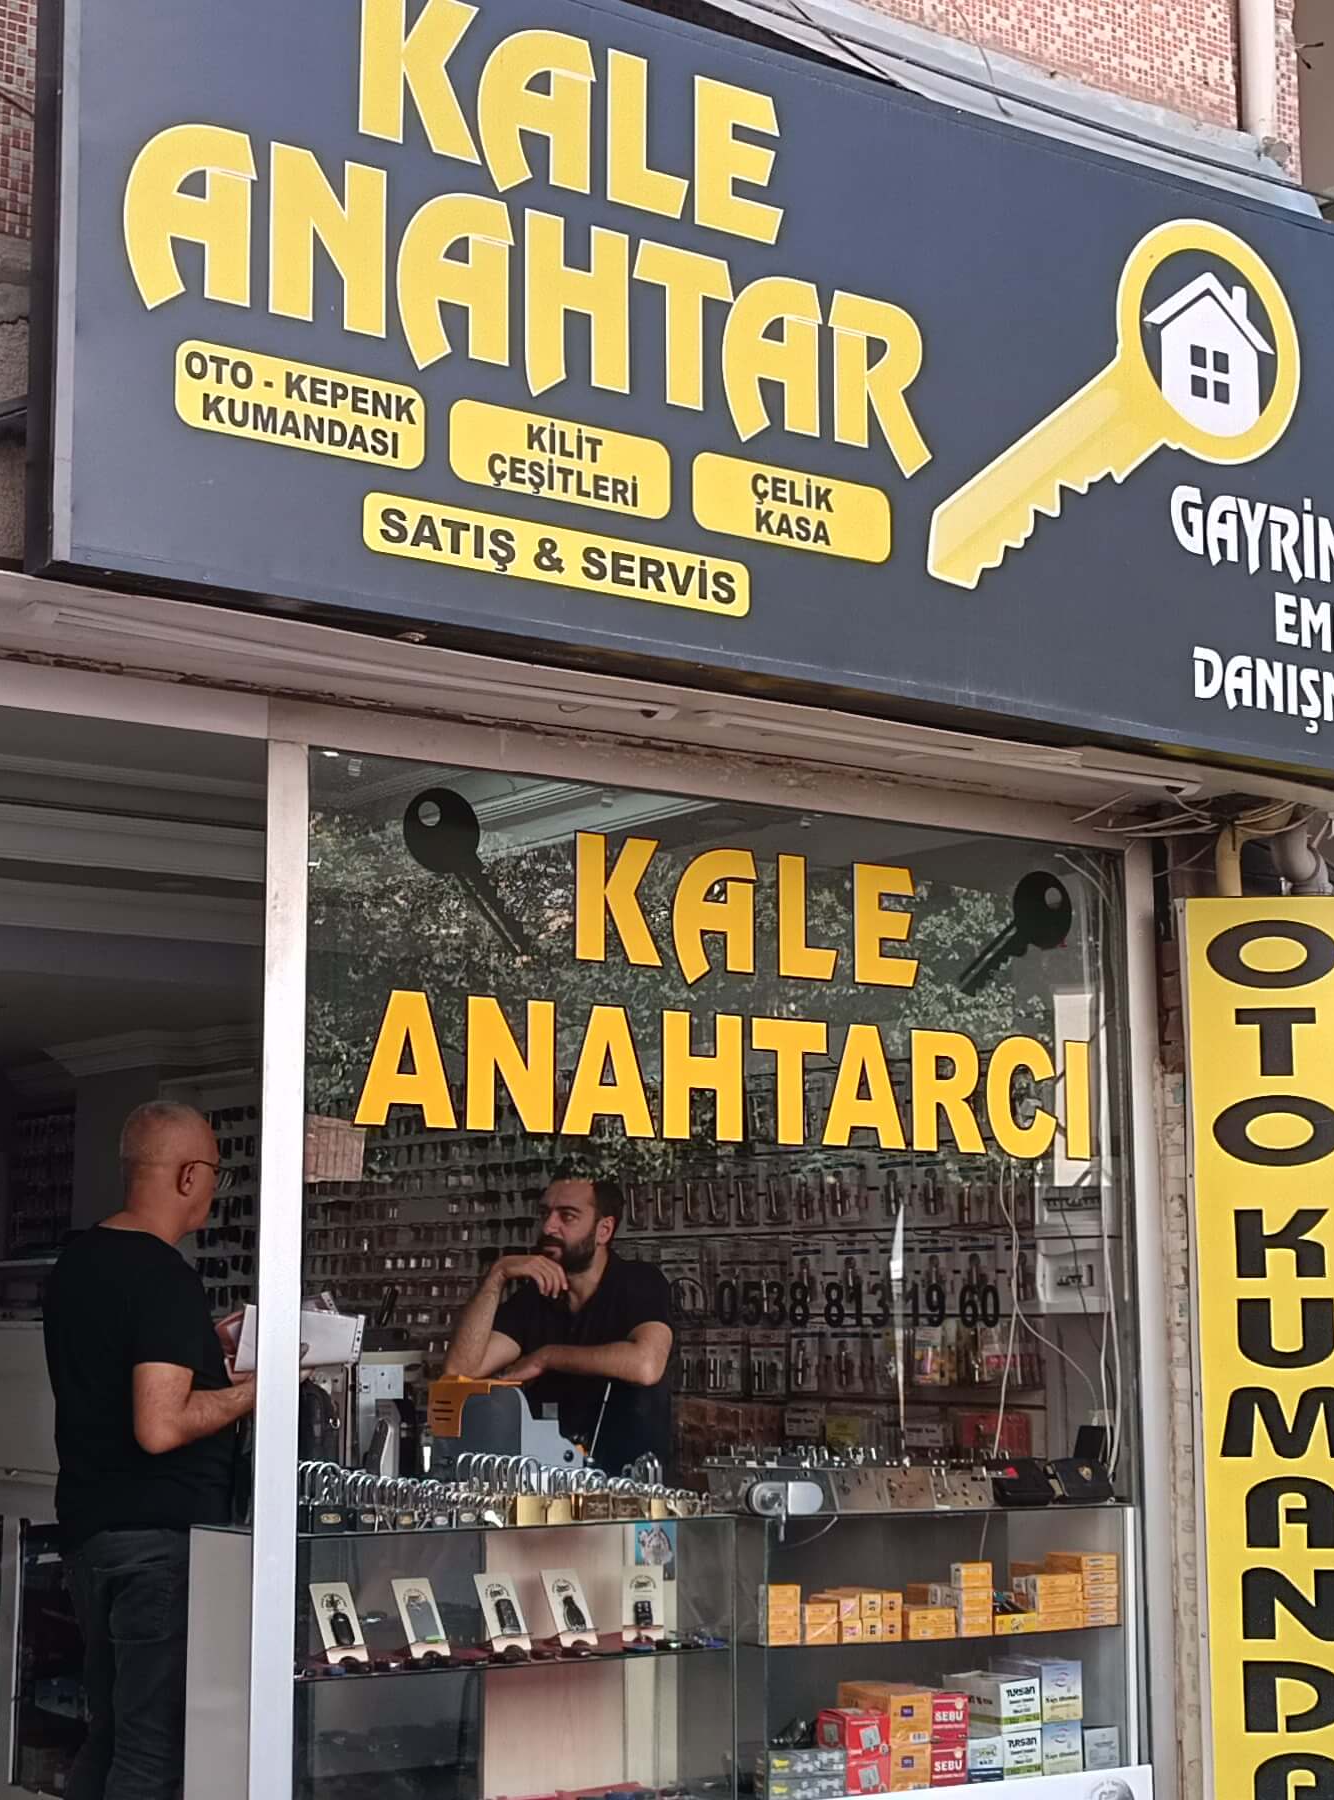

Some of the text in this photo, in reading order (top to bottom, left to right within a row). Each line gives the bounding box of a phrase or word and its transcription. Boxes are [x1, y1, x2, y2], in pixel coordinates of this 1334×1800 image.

[358, 0, 785, 246] KALE
[123, 122, 933, 479] ANAHTAR
[185, 351, 251, 389] OTO
[284, 371, 418, 426] KEPENK
[201, 392, 400, 459] KUMANDASI
[525, 422, 604, 464] KİLİT
[487, 453, 640, 509] ÇEŞİTLERİ
[751, 472, 835, 513] ÇELİK
[379, 507, 738, 606] SATIŞ & SERVİS
[753, 507, 832, 547] KASA
[574, 830, 919, 989] KALE
[353, 989, 1093, 1161] ANAHTARCI
[716, 1278, 1000, 1329] 0538 813 19 60
[934, 1710, 964, 1723] SEBU
[933, 1759, 963, 1773] SEBU
